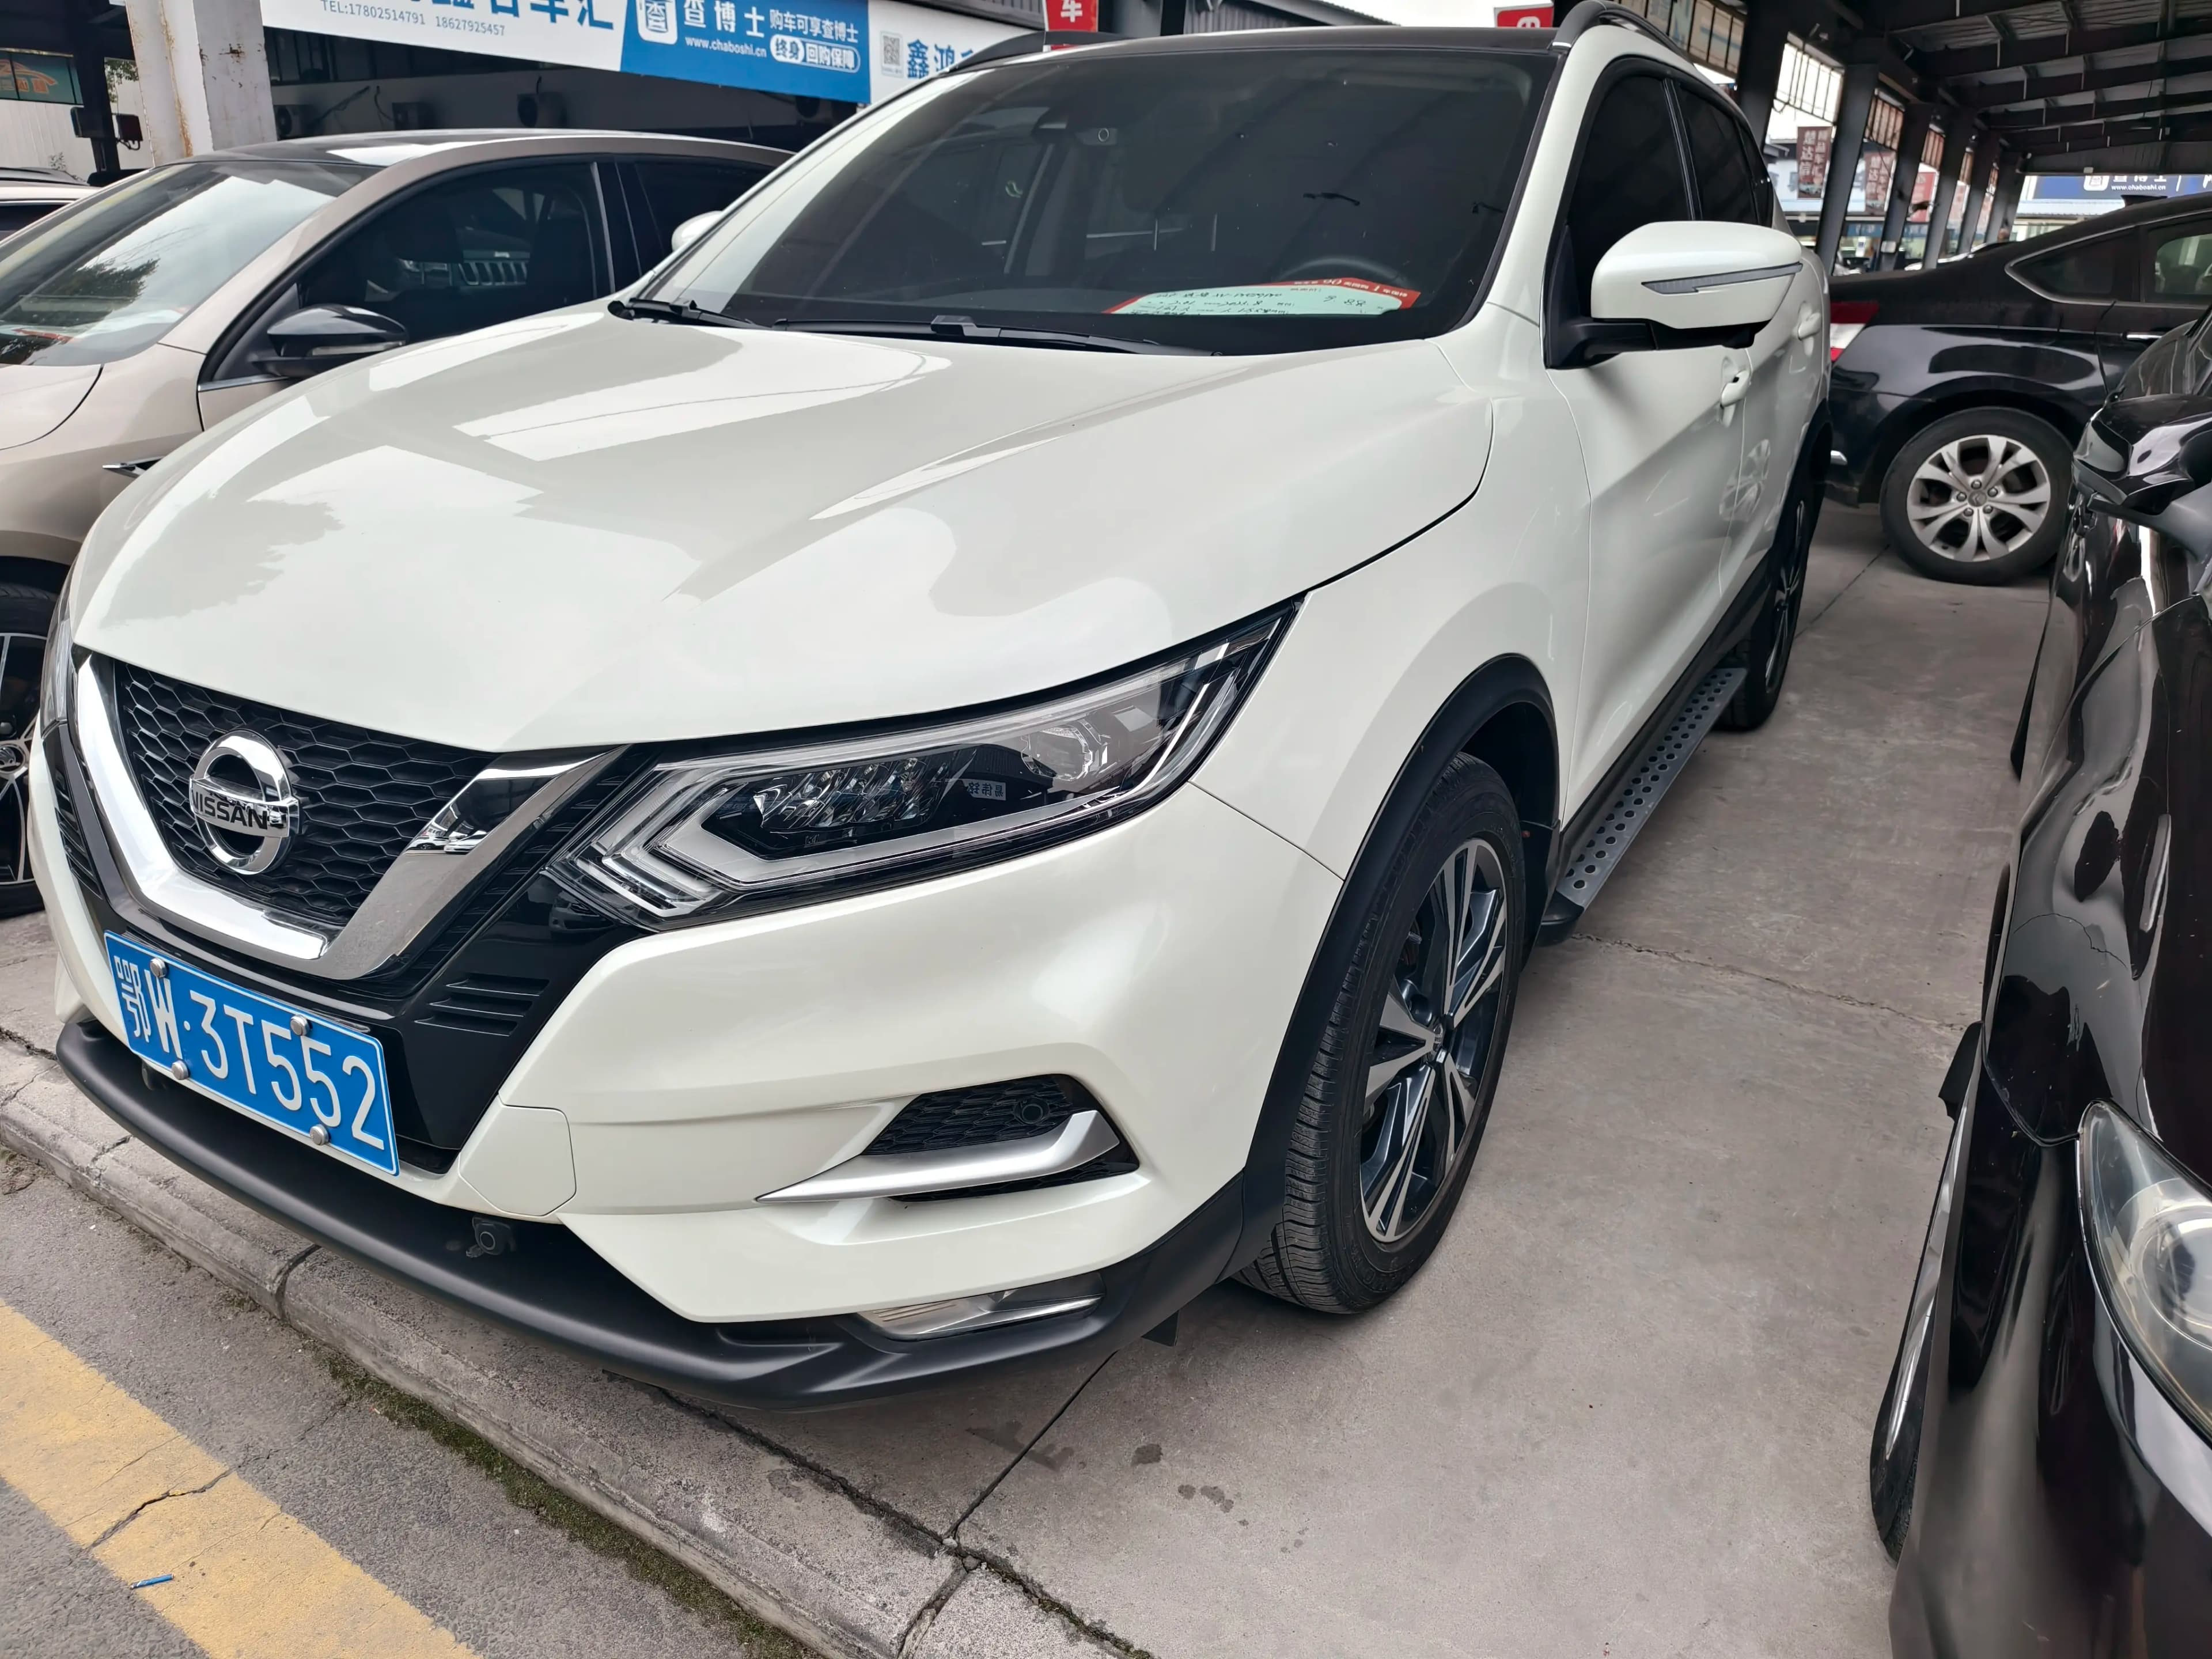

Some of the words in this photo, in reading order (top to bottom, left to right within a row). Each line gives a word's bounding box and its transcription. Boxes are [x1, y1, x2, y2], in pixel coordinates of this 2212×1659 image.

[322, 0, 426, 25] TEL:17802514791
[435, 16, 505, 36] 18627925457
[684, 0, 765, 38] 查博士
[769, 9, 858, 43] 购车可享查博士
[684, 36, 767, 58] www.chaboshi.cn
[775, 37, 800, 60] 终身
[907, 39, 974, 78] 鑫鸿
[192, 790, 268, 830] NISSAN
